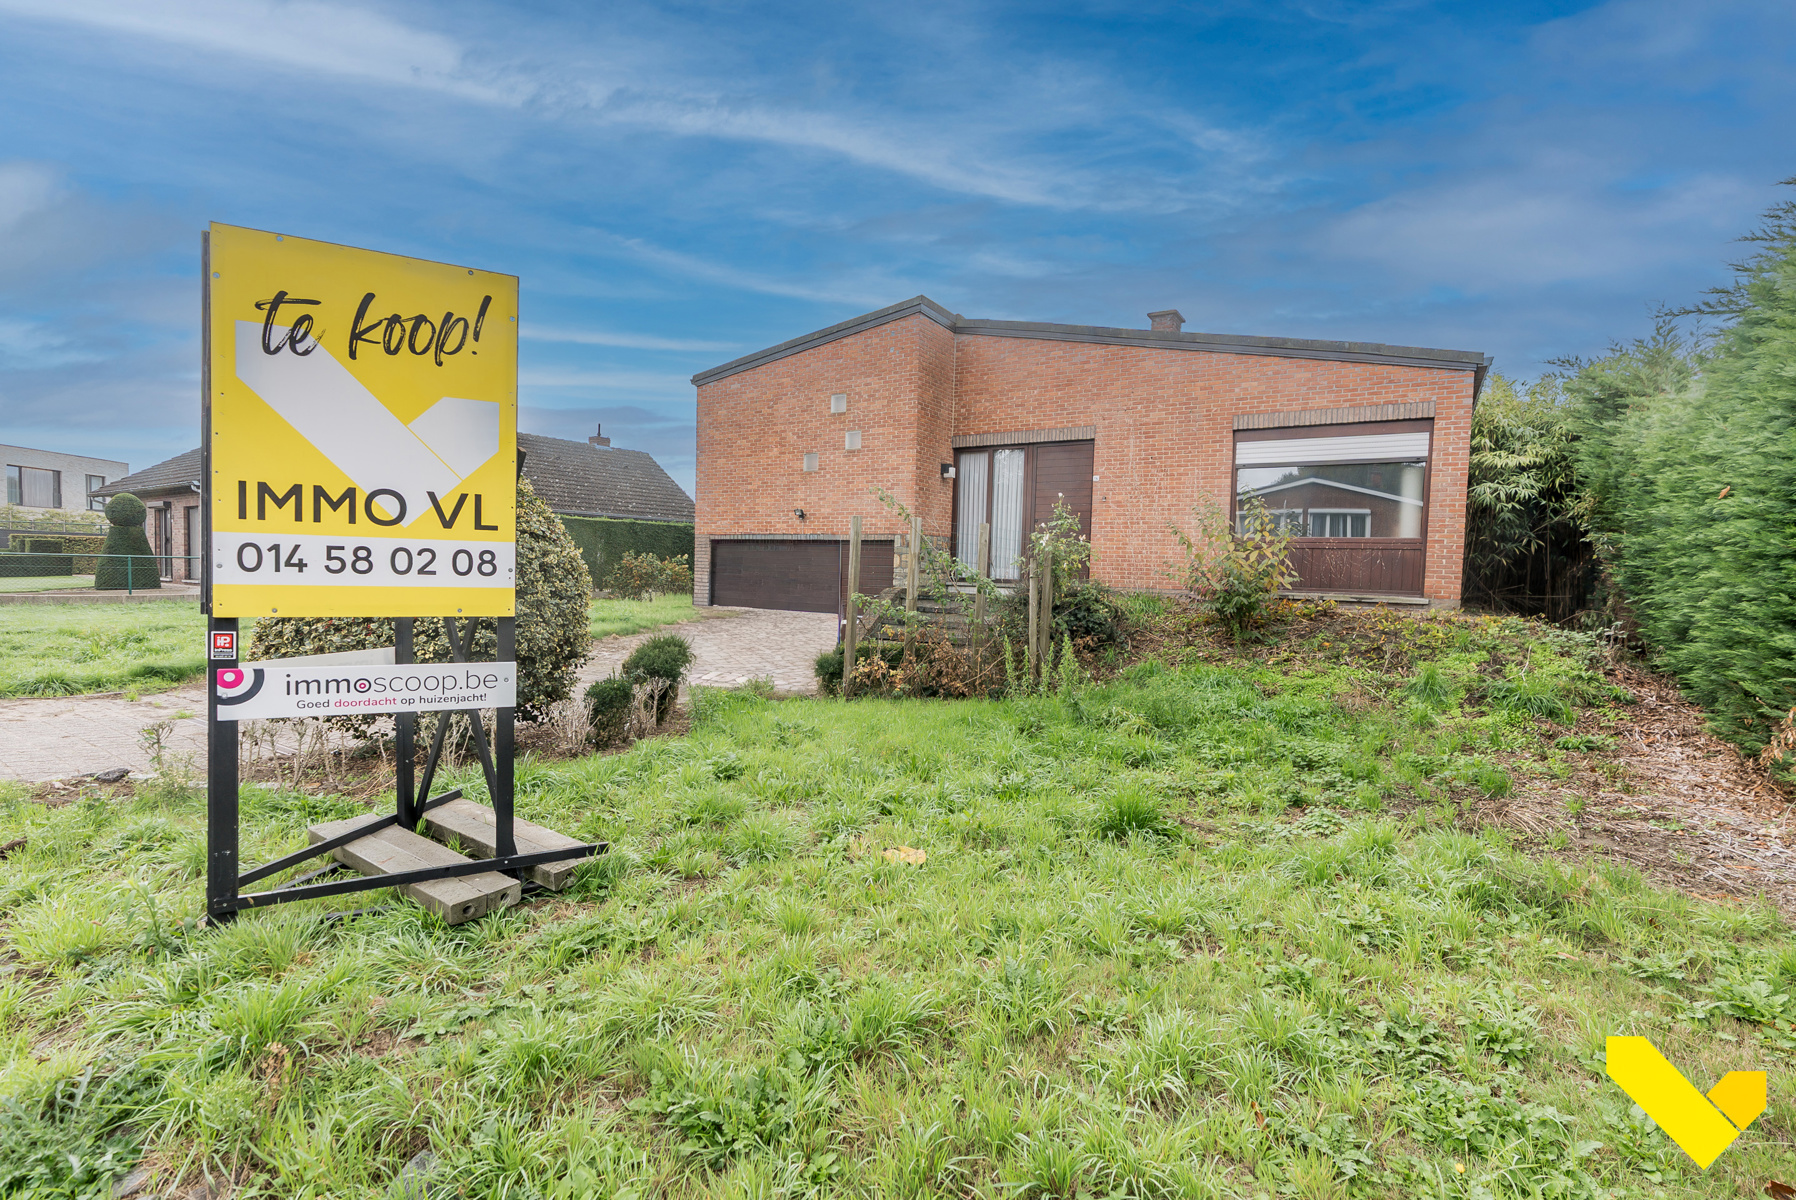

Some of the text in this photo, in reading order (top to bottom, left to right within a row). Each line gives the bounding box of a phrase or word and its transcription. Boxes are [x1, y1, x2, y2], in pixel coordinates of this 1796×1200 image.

[254, 290, 493, 367] te koop!
[238, 480, 499, 531] IMMO VL
[236, 542, 498, 577] 014 58 02 08
[285, 670, 498, 696] immoscoop.be
[296, 693, 487, 709] Goed doordacht op huizenjacht!
